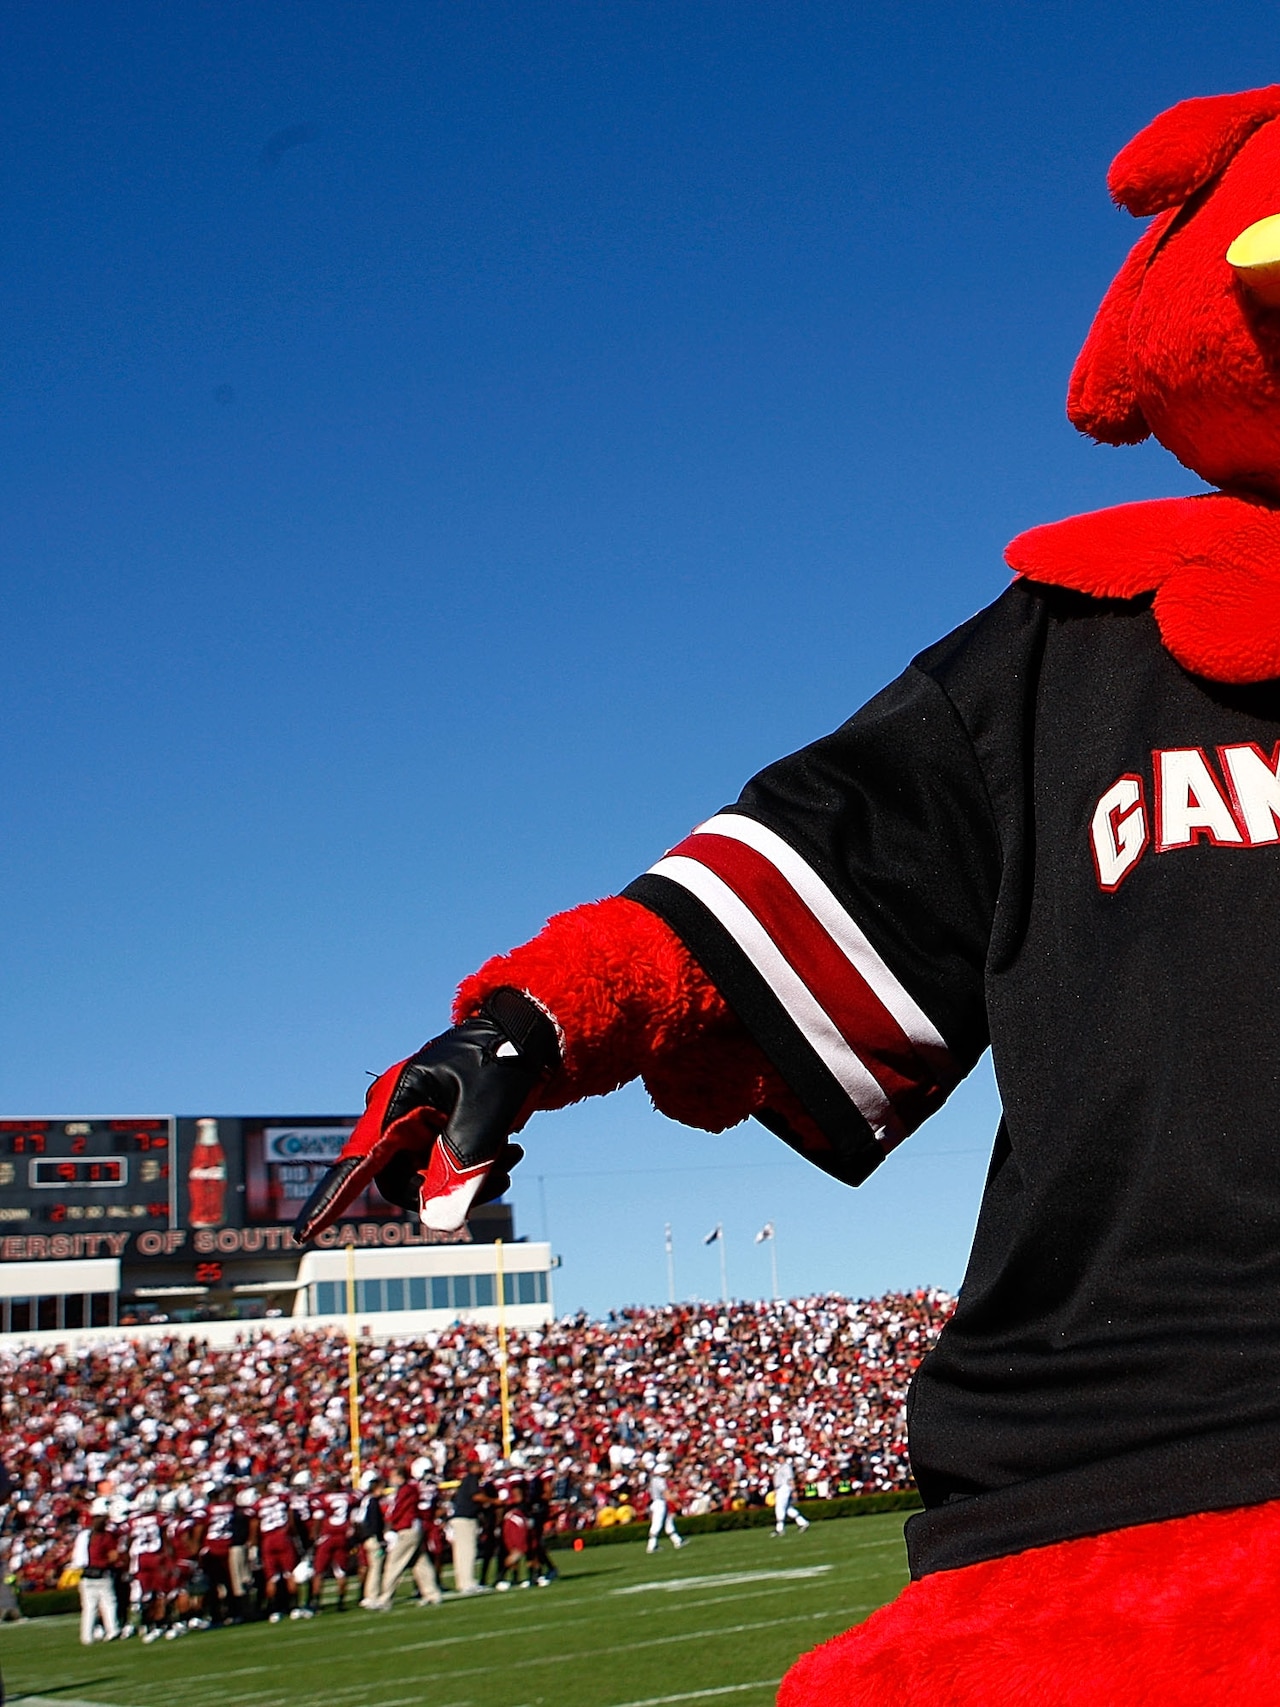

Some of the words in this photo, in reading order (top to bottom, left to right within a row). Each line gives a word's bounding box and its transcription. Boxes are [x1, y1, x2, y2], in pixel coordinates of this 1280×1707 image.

[14, 1133, 46, 1153] 17
[0, 1231, 130, 1260] ERSITY
[136, 1229, 186, 1256] OF
[195, 1262, 223, 1283] 25
